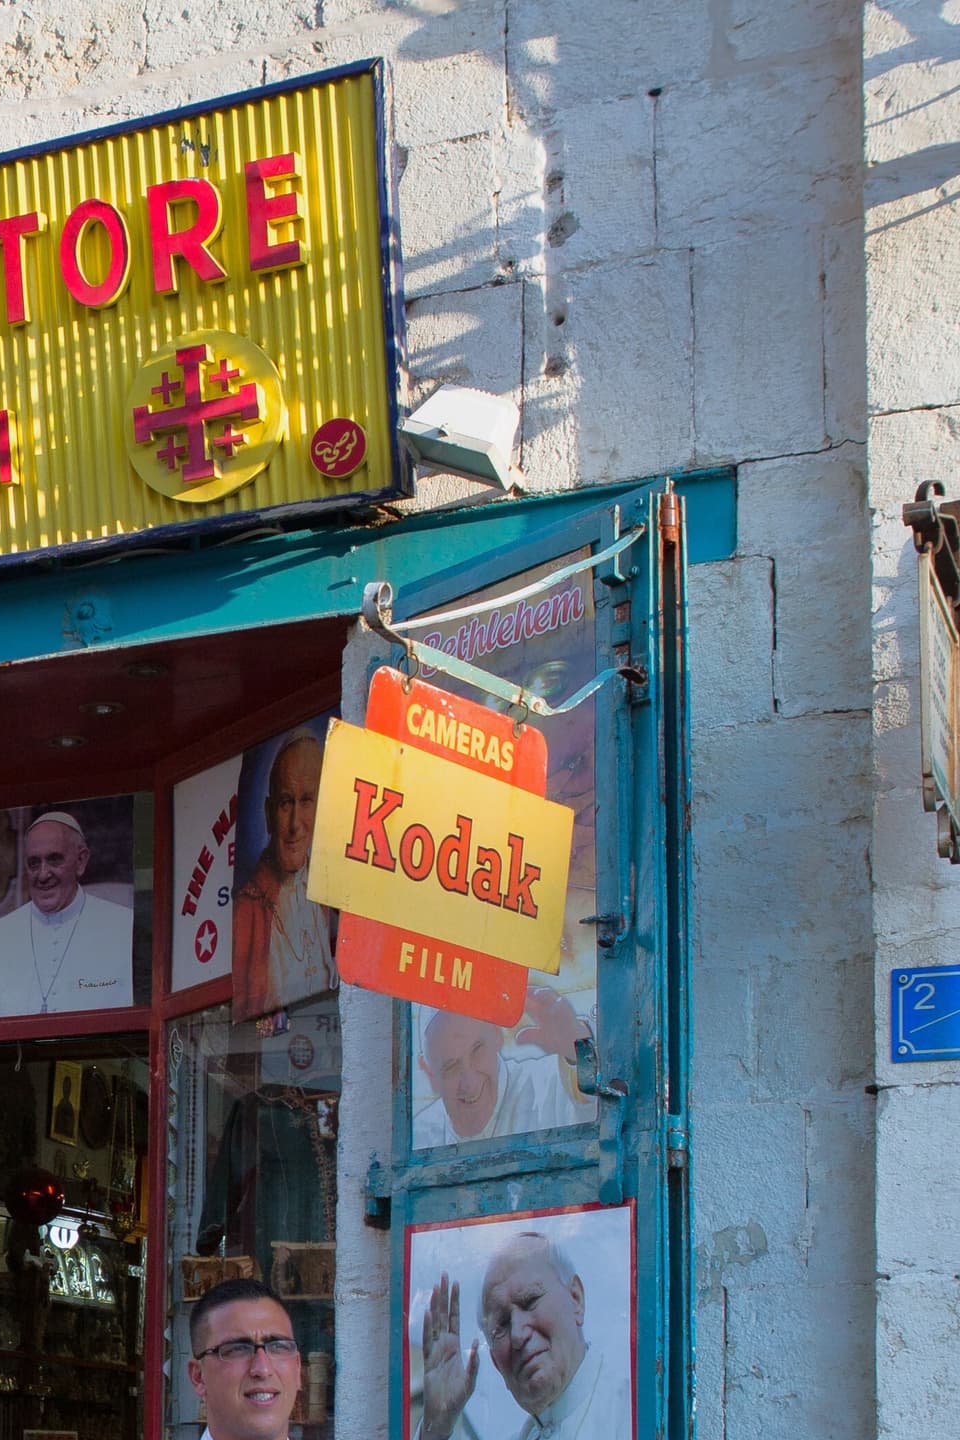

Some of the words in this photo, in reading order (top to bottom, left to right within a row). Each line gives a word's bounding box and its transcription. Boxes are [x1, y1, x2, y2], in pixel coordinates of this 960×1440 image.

[406, 704, 514, 771] CAMERAS
[345, 778, 540, 918] Kodak
[398, 943, 473, 991] FILM
[913, 983, 935, 1010] 2
